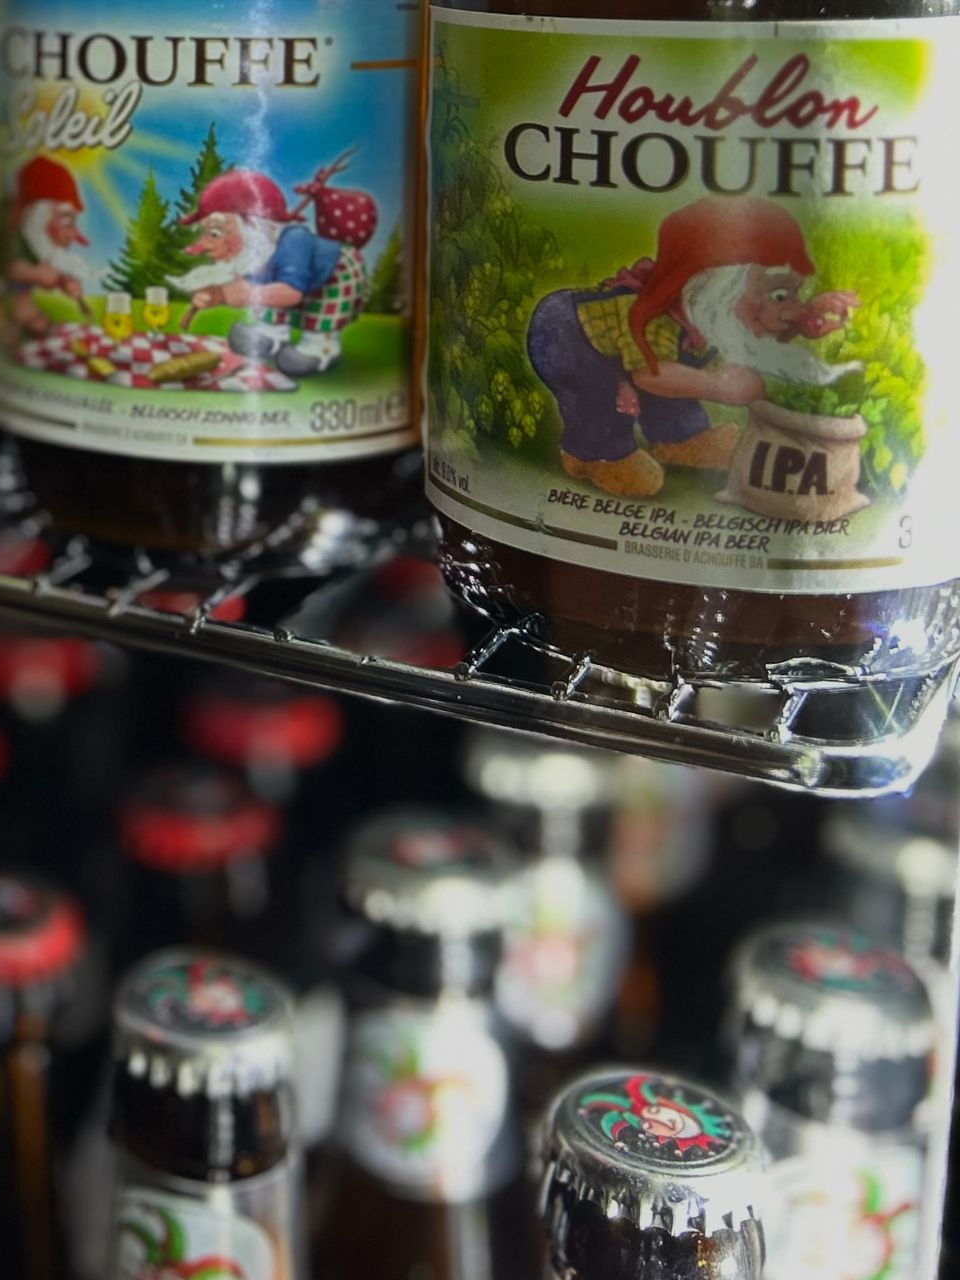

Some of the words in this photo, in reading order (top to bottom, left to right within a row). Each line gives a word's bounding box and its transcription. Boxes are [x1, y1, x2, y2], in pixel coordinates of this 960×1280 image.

[1, 25, 321, 88] CHOUFFE
[558, 53, 879, 131] Houblon
[503, 122, 920, 198] CHOUFFE
[547, 488, 589, 510] BIÈRE
[593, 498, 646, 520] BELGE
[649, 507, 676, 525] IPA
[695, 513, 783, 533] BELGISCH
[784, 519, 810, 534] IPA
[813, 519, 850, 536] BIER
[619, 522, 692, 545] BELGIAN
[693, 529, 721, 547] IPA
[725, 534, 770, 553] BEER
[624, 540, 680, 562] BRASSERIE
